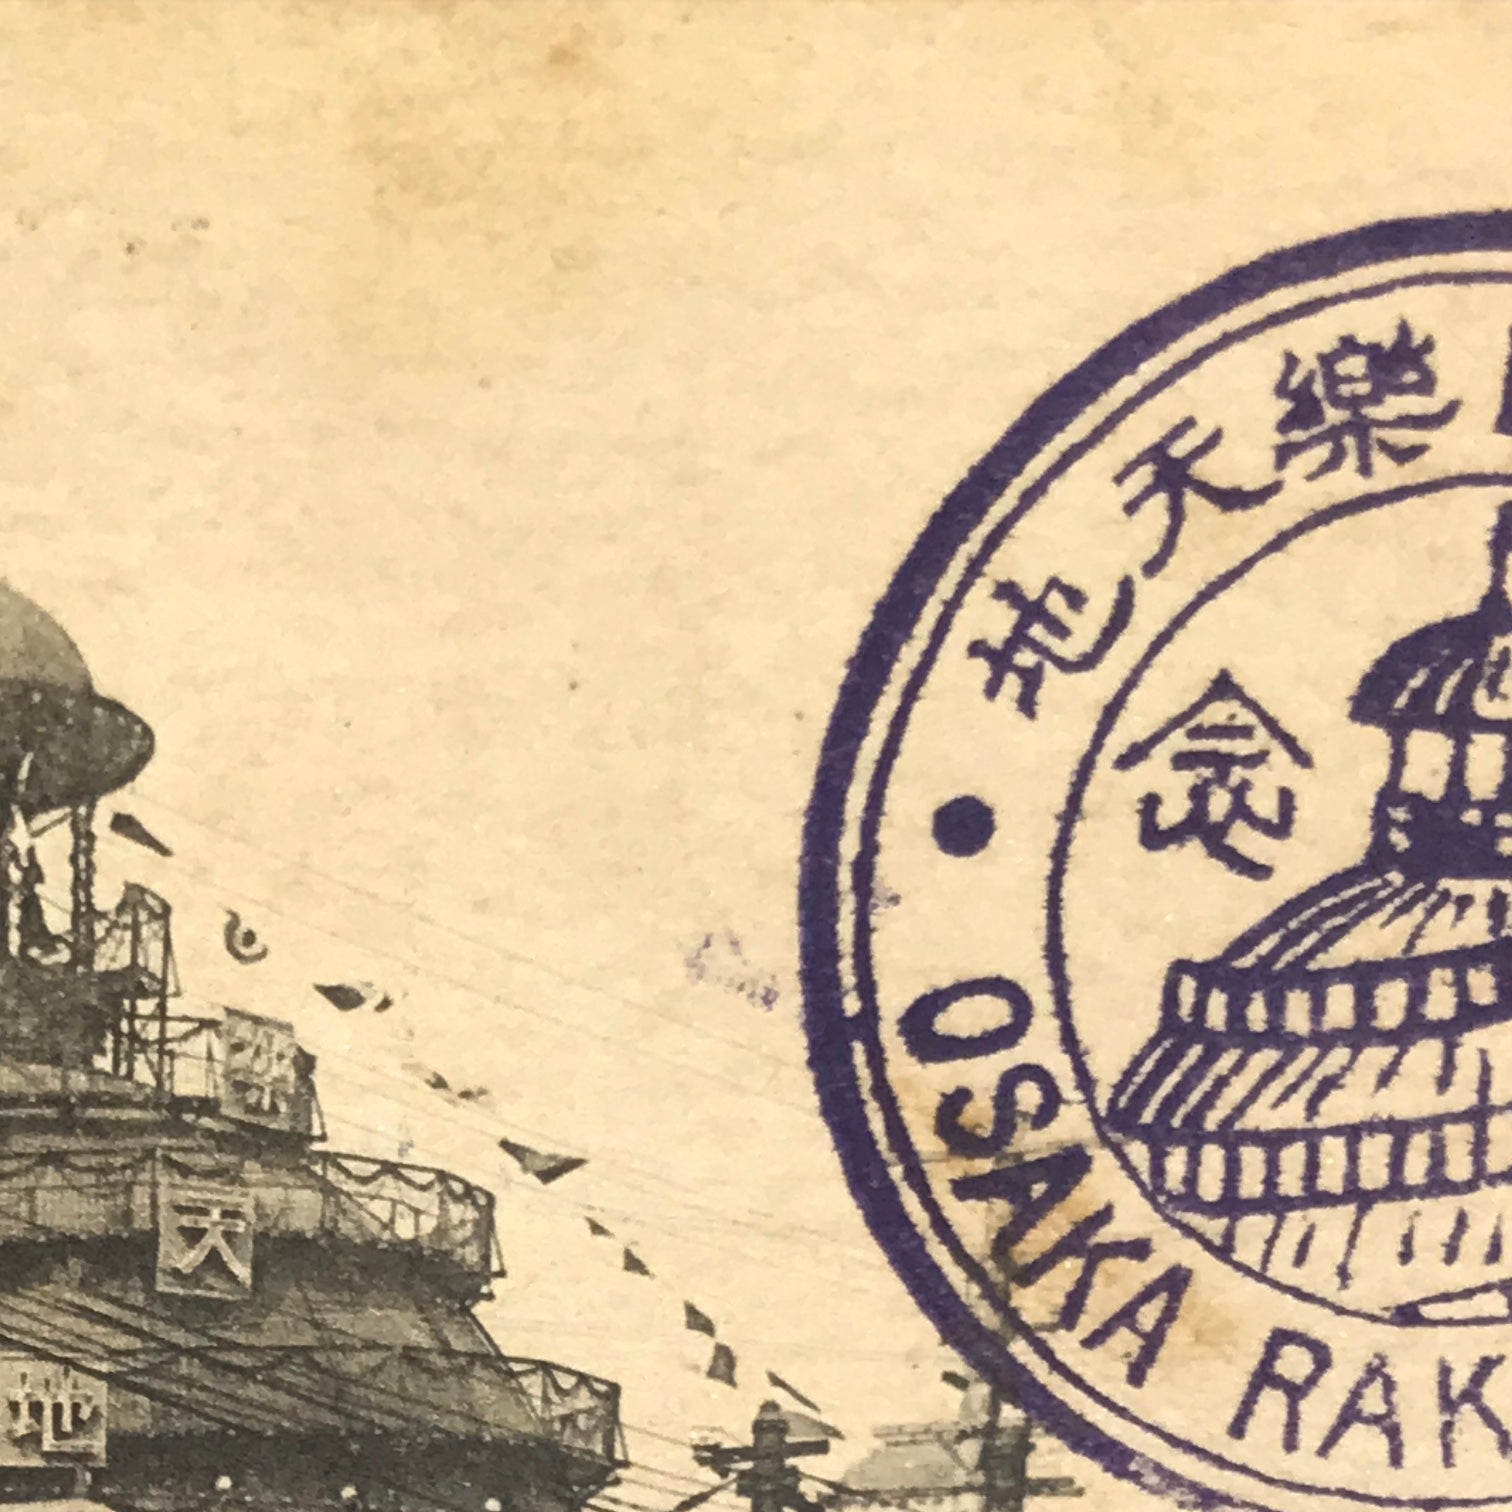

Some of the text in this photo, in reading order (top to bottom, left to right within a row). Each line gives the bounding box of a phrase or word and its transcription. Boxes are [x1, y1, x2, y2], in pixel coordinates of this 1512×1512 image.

[967, 318, 1512, 720] 樂天地
[1113, 667, 1314, 882] 念
[174, 1186, 253, 1286] 天
[897, 975, 1194, 1389] OSAKA
